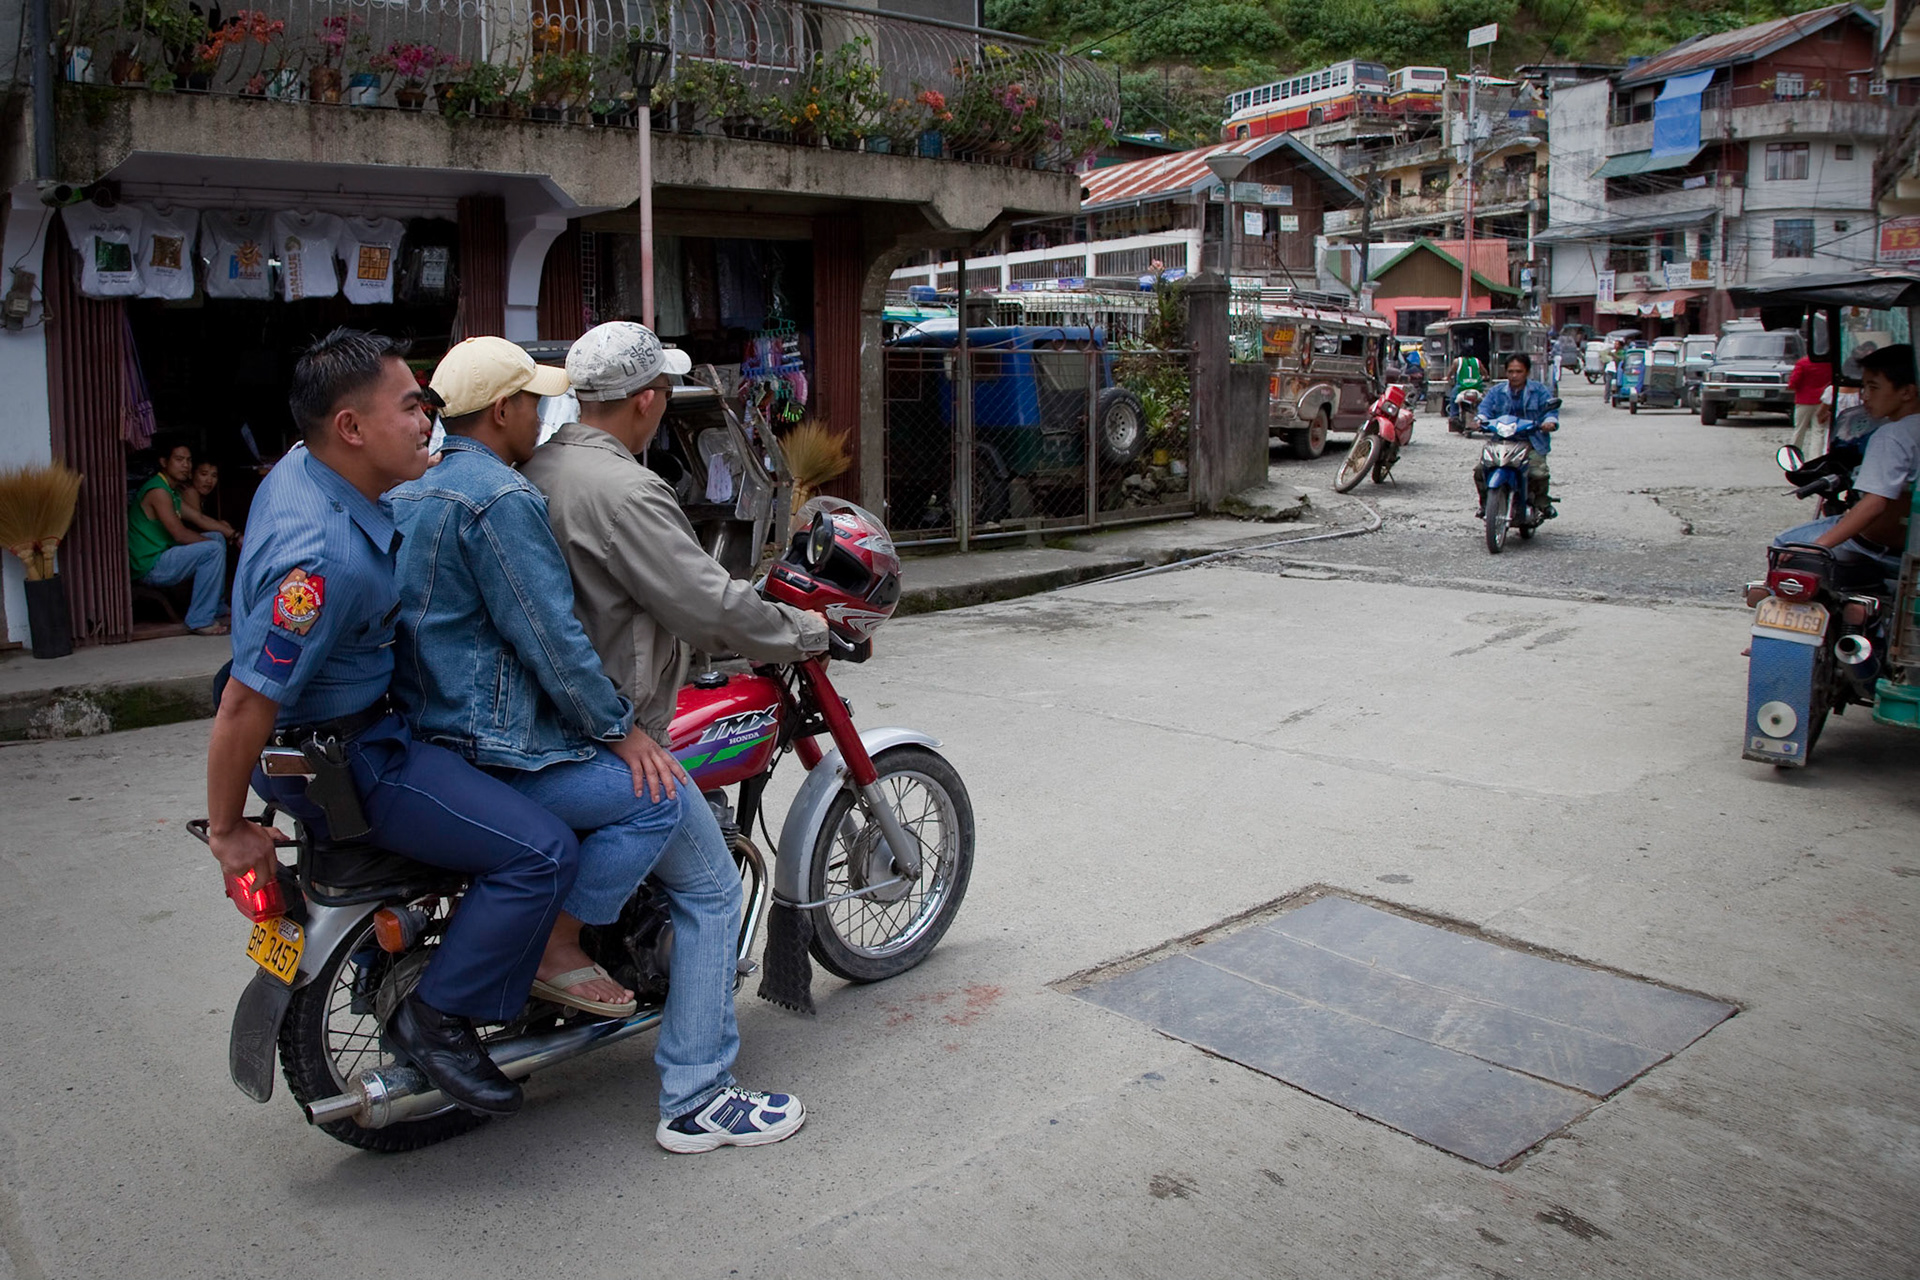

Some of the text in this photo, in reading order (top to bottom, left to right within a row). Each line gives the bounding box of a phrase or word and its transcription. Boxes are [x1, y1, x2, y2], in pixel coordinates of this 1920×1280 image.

[287, 253, 300, 300] BANAUE
[1784, 612, 1822, 631] 6169
[729, 732, 760, 745] HONDA
[249, 924, 267, 955] BR
[264, 936, 299, 976] 3457
